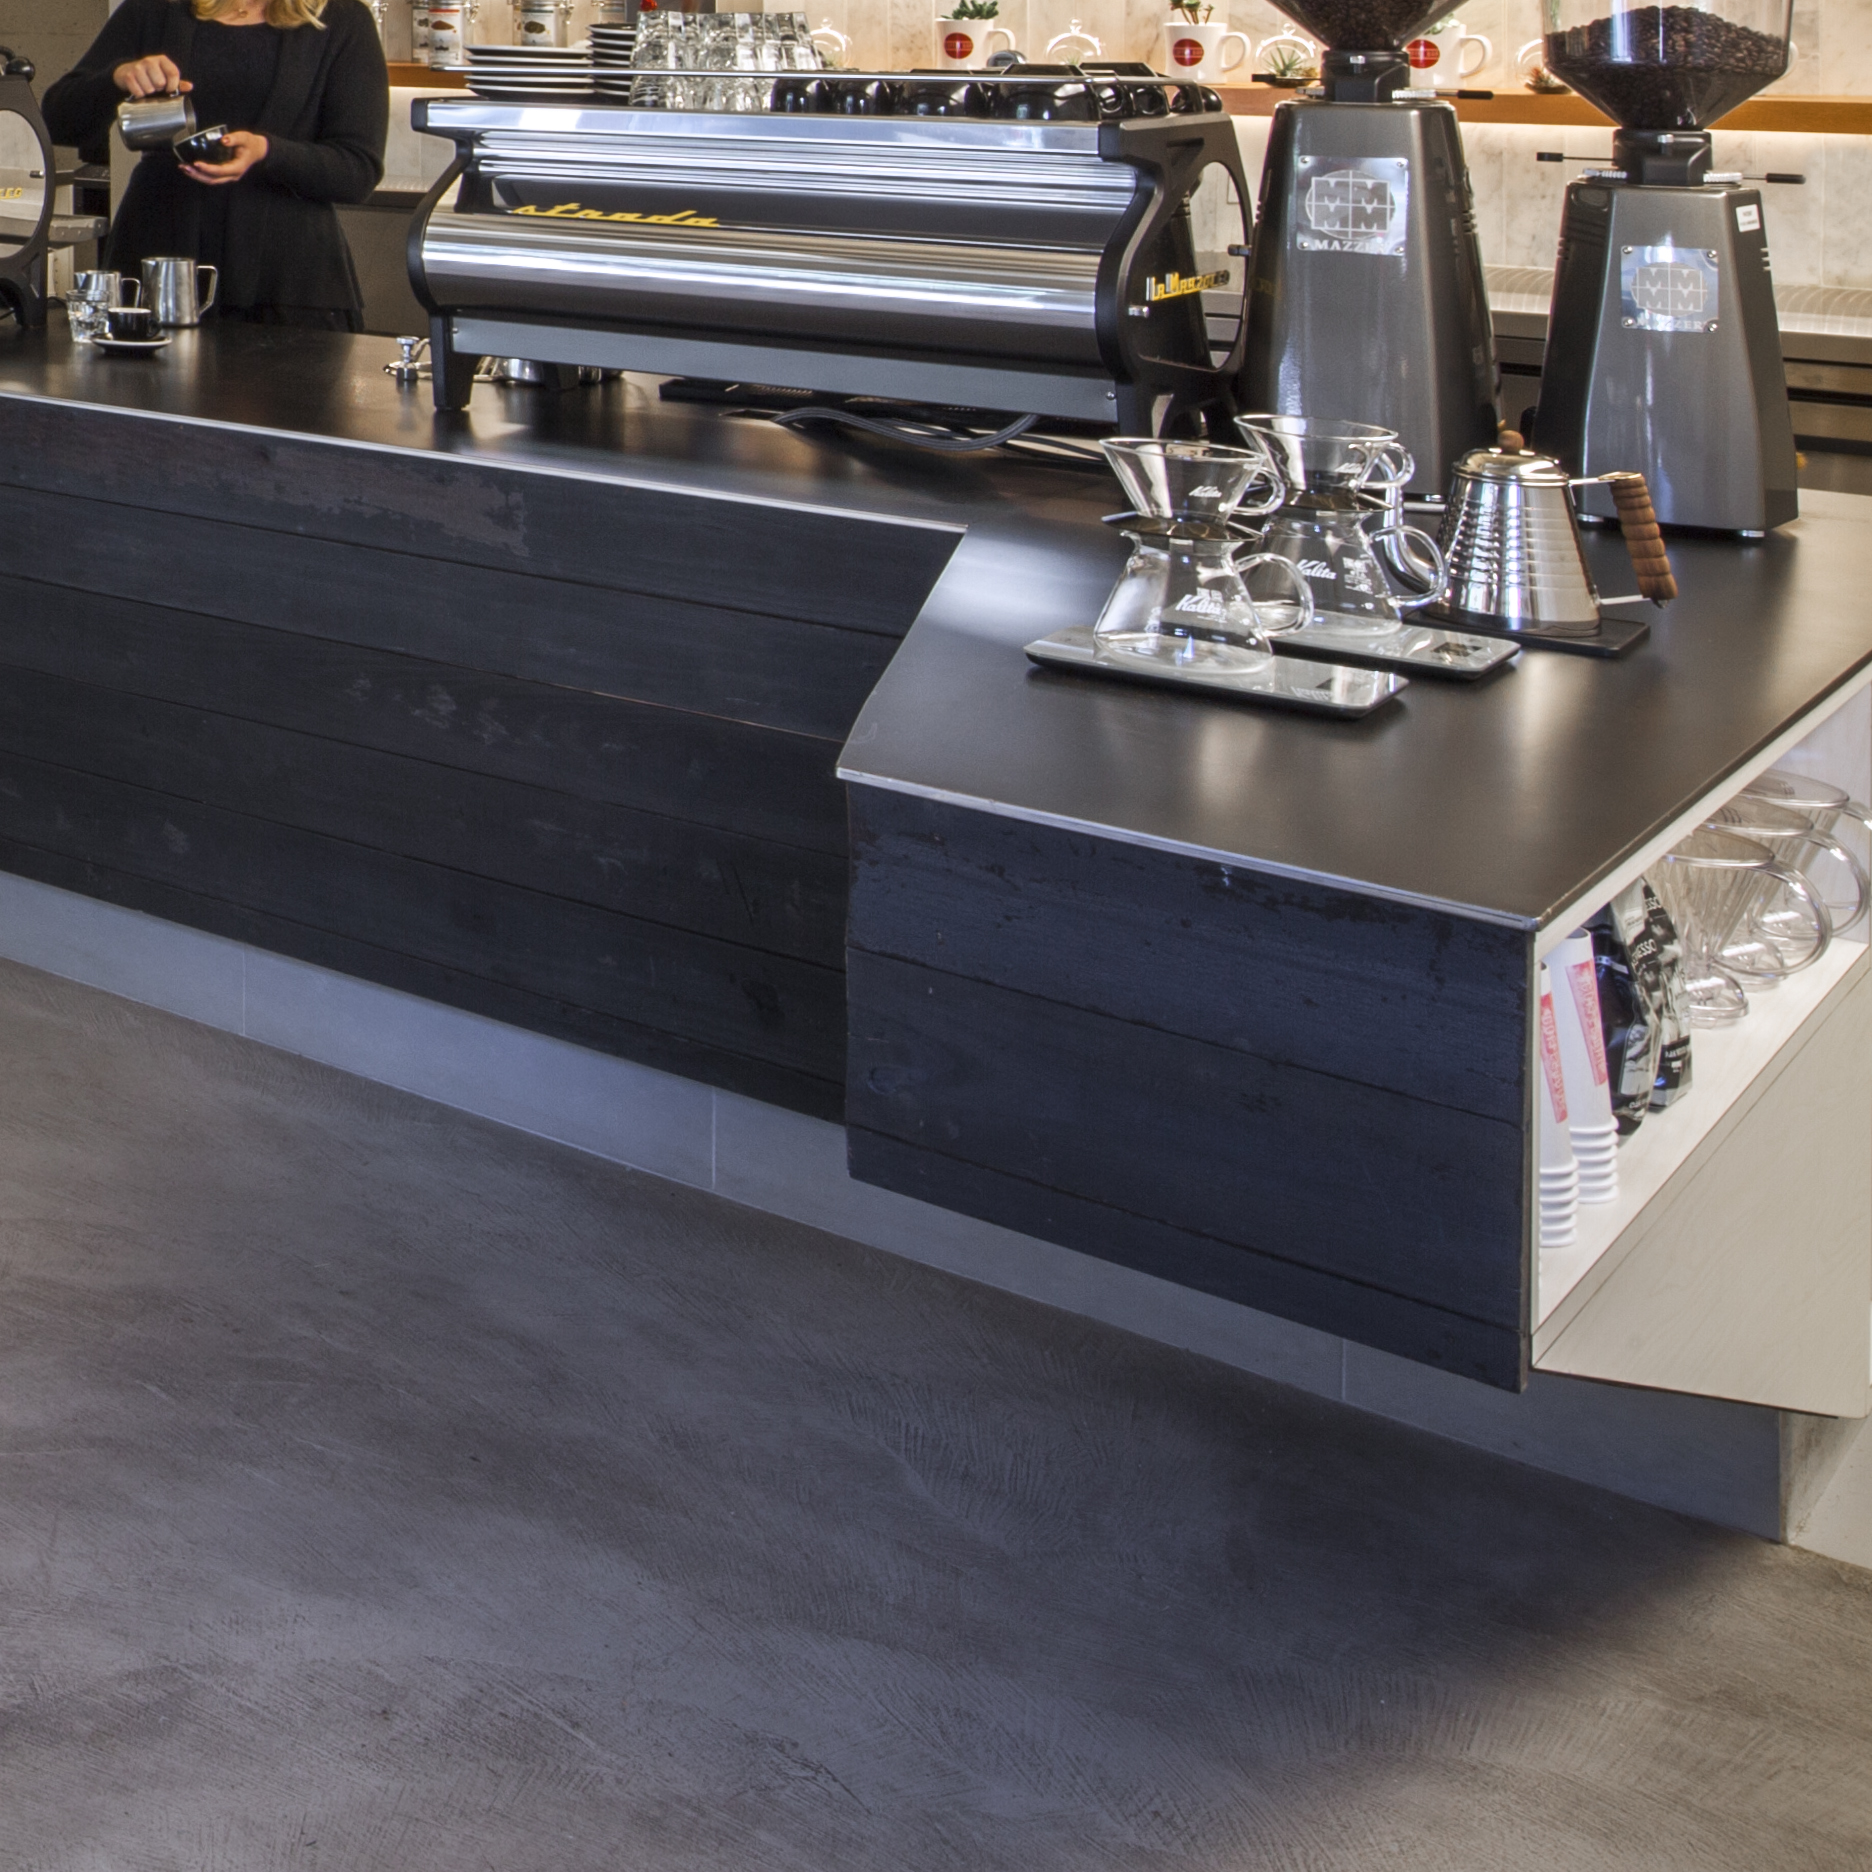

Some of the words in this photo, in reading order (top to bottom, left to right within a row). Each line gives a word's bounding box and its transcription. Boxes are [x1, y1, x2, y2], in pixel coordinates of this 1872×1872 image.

[512, 203, 720, 227] strada
[1189, 485, 1223, 498] Kalita
[1296, 559, 1337, 580] Kalita
[1175, 594, 1222, 615] Kalita
